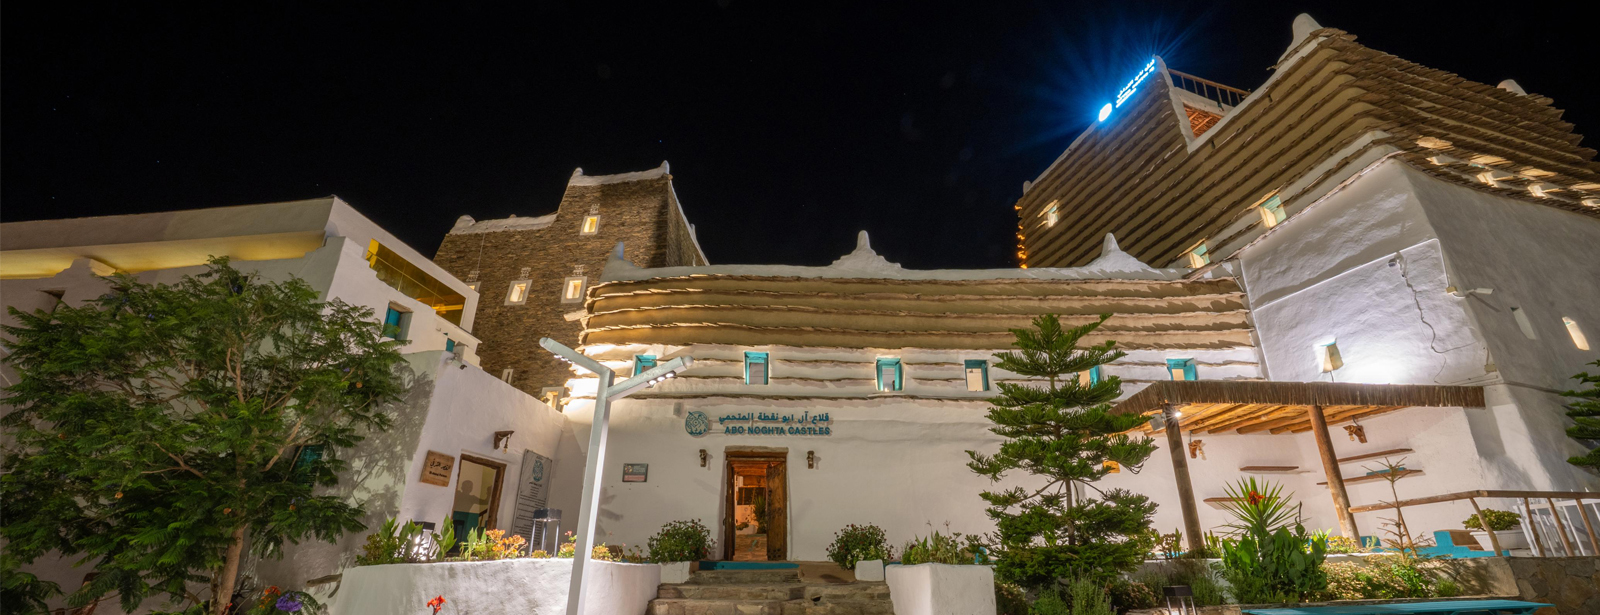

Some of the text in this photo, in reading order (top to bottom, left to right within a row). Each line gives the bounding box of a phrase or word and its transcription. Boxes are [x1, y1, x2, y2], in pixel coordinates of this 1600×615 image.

[718, 412, 754, 425] المتحمي
[757, 412, 779, 421] نقطة
[797, 410, 809, 424] آل
[811, 412, 830, 425] قلاع
[724, 425, 831, 436] ABO NOGHTA CASTLES
